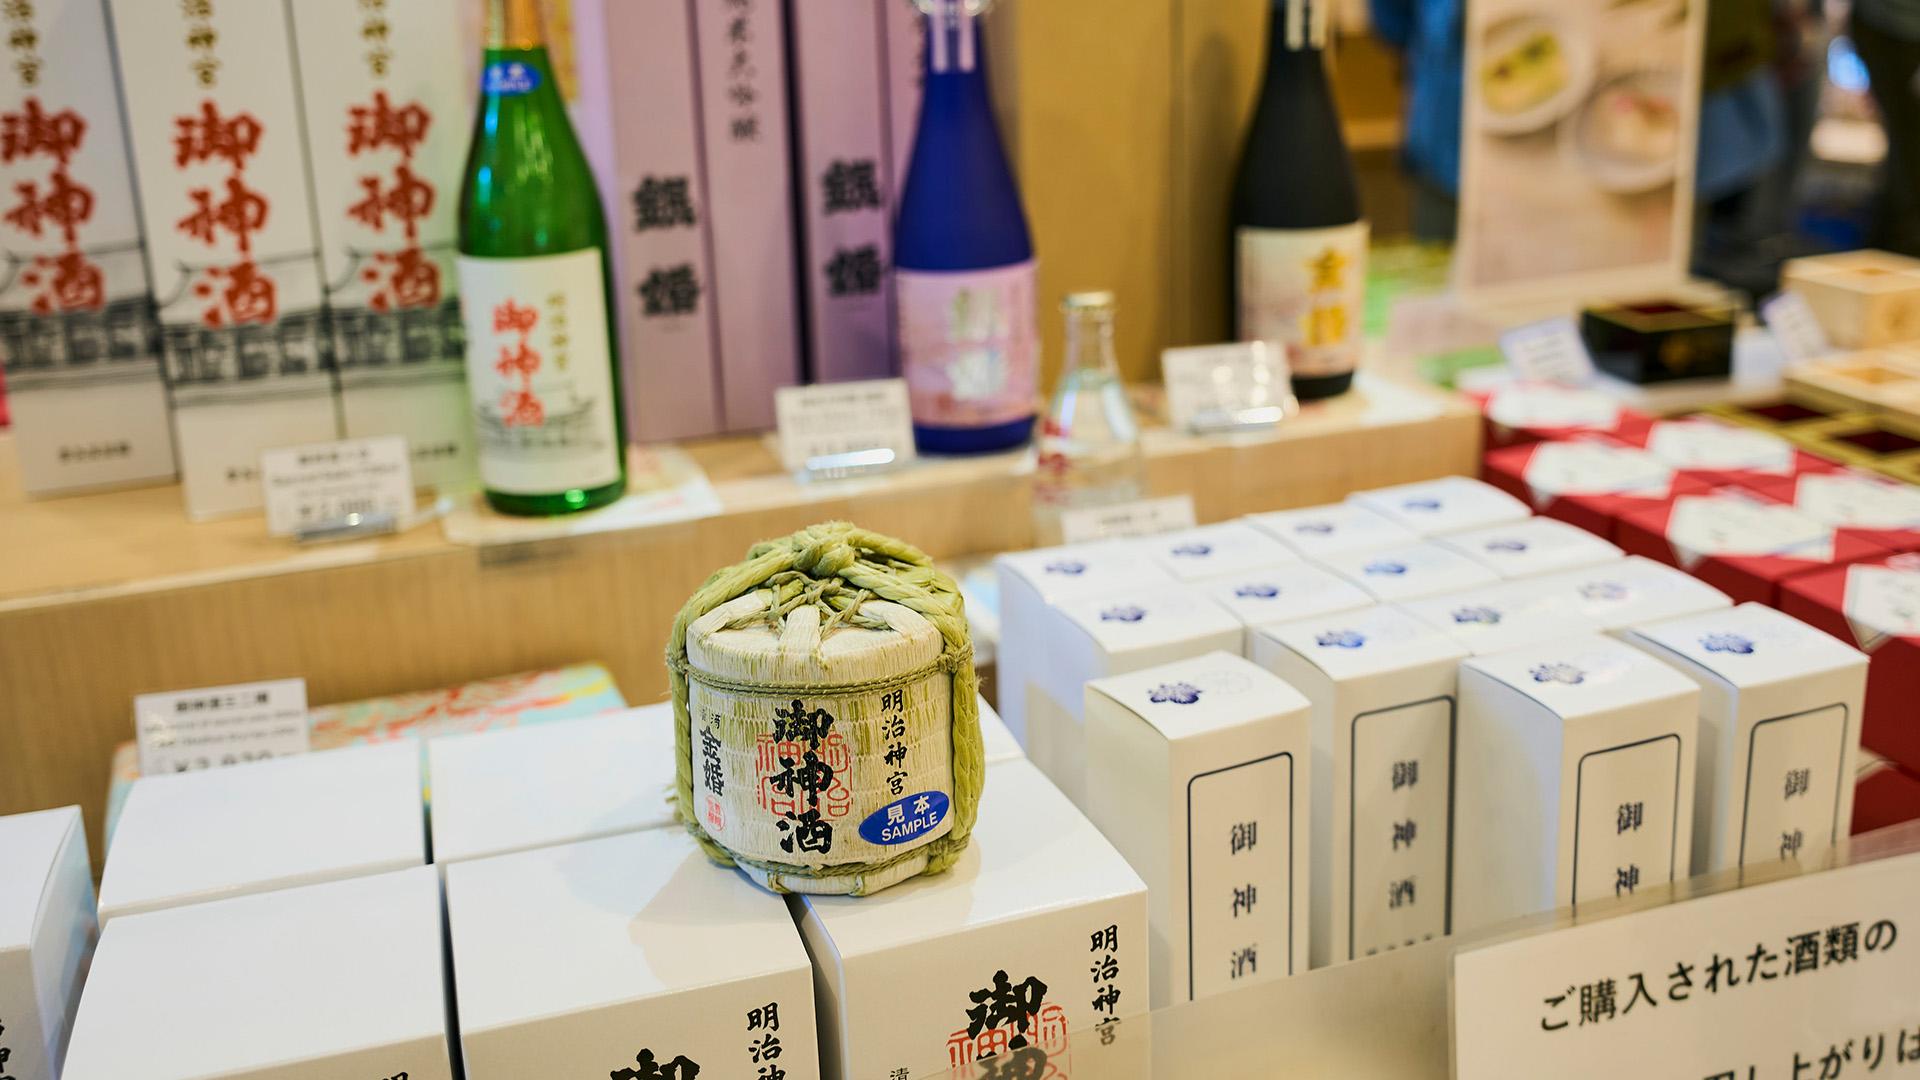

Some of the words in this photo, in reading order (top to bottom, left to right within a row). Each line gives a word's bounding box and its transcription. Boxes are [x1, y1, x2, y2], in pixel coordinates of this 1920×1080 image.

[2, 98, 105, 316] 御神酒
[173, 100, 276, 328] 御神酒
[347, 91, 441, 311] 御神酒
[493, 299, 543, 427] 御神酒
[770, 700, 834, 853] 御神酒
[880, 689, 908, 795] 明治神宮
[881, 811, 938, 842] SAMPLE
[887, 795, 930, 826] 見本
[1230, 821, 1257, 980] 御神酒
[1090, 924, 1121, 1046] 明治神宮
[1540, 918, 1898, 1031] ご購入された酒類の
